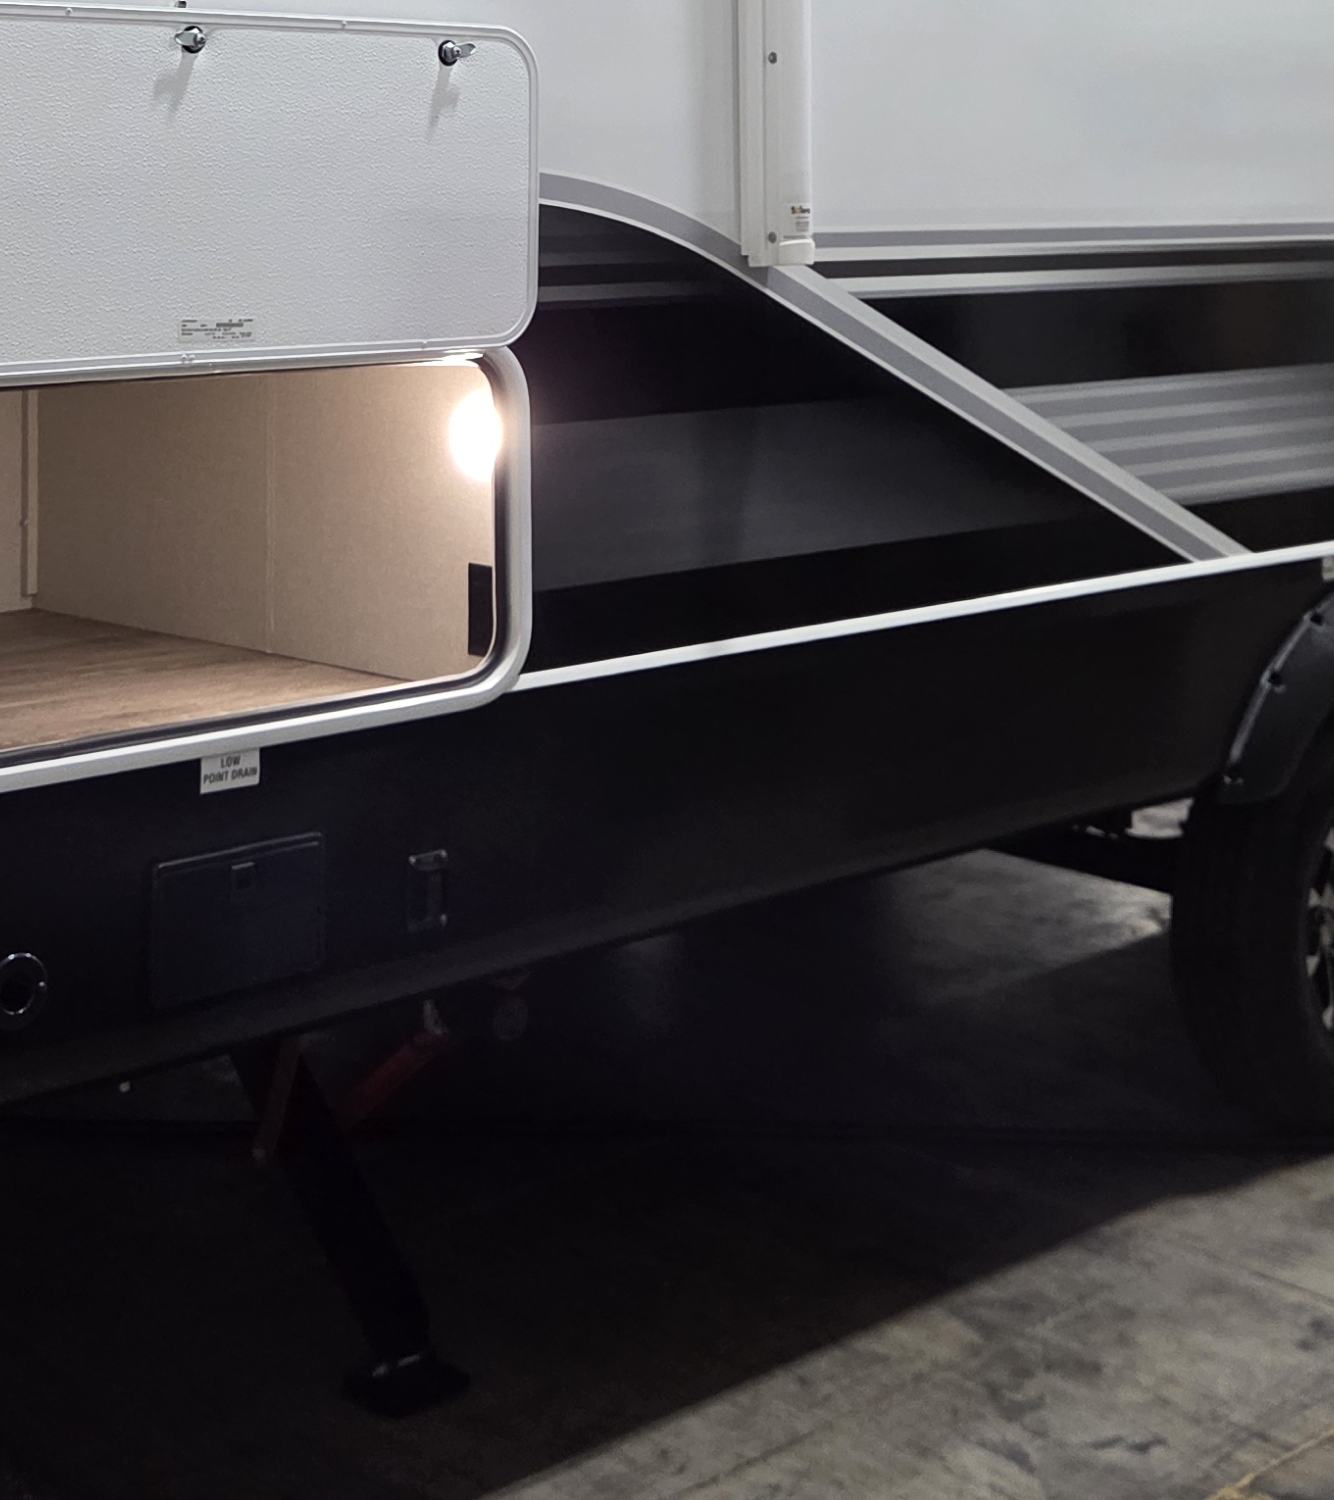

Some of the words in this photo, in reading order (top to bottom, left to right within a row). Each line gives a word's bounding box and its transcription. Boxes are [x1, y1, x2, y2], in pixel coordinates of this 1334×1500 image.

[220, 755, 241, 769] LOW
[203, 770, 229, 784] POINT
[231, 766, 258, 780] DRAIN
